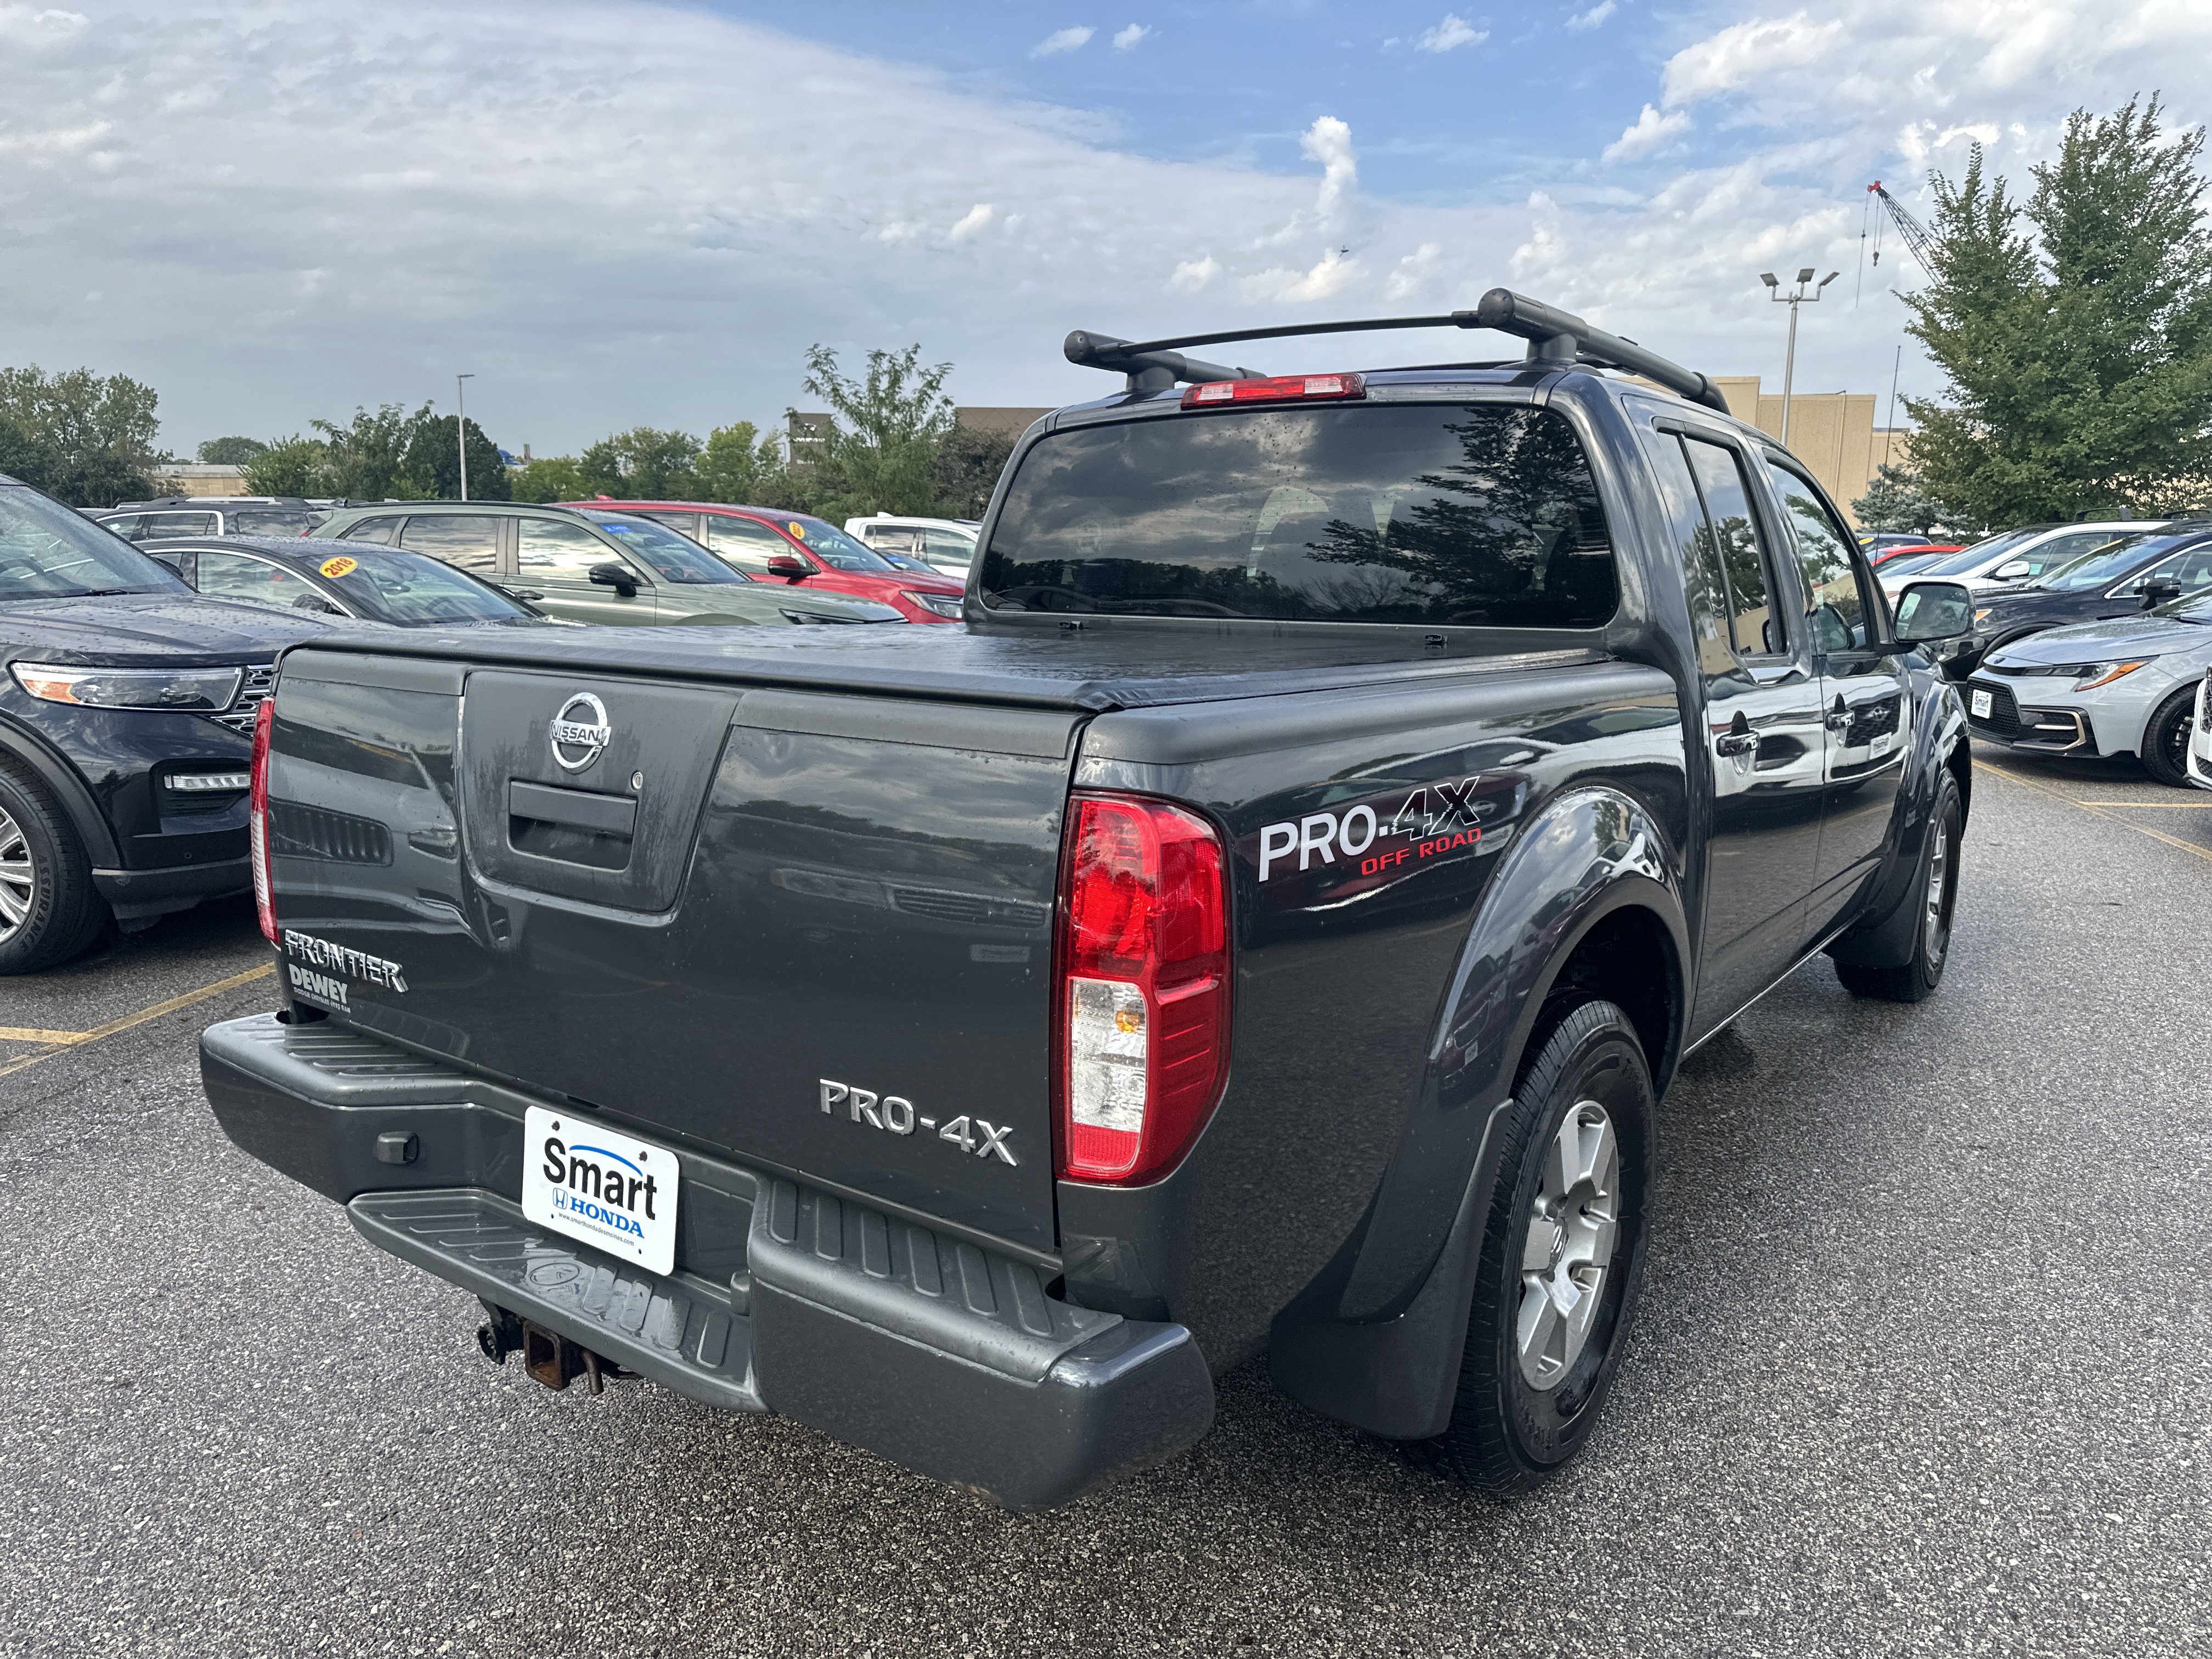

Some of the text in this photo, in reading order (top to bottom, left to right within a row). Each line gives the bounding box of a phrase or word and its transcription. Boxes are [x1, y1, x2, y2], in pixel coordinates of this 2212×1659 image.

[324, 558, 353, 576] 2018
[551, 724, 600, 741] NISSAN
[1361, 827, 1482, 876] OFF ROAD
[19, 854, 51, 950] ASSURANCE
[285, 929, 409, 992] FRONTIER
[289, 963, 348, 1005] DEWEY
[820, 1079, 1018, 1167] PRO-4X
[543, 1137, 657, 1221] Smart
[570, 1197, 645, 1239] HONDA
